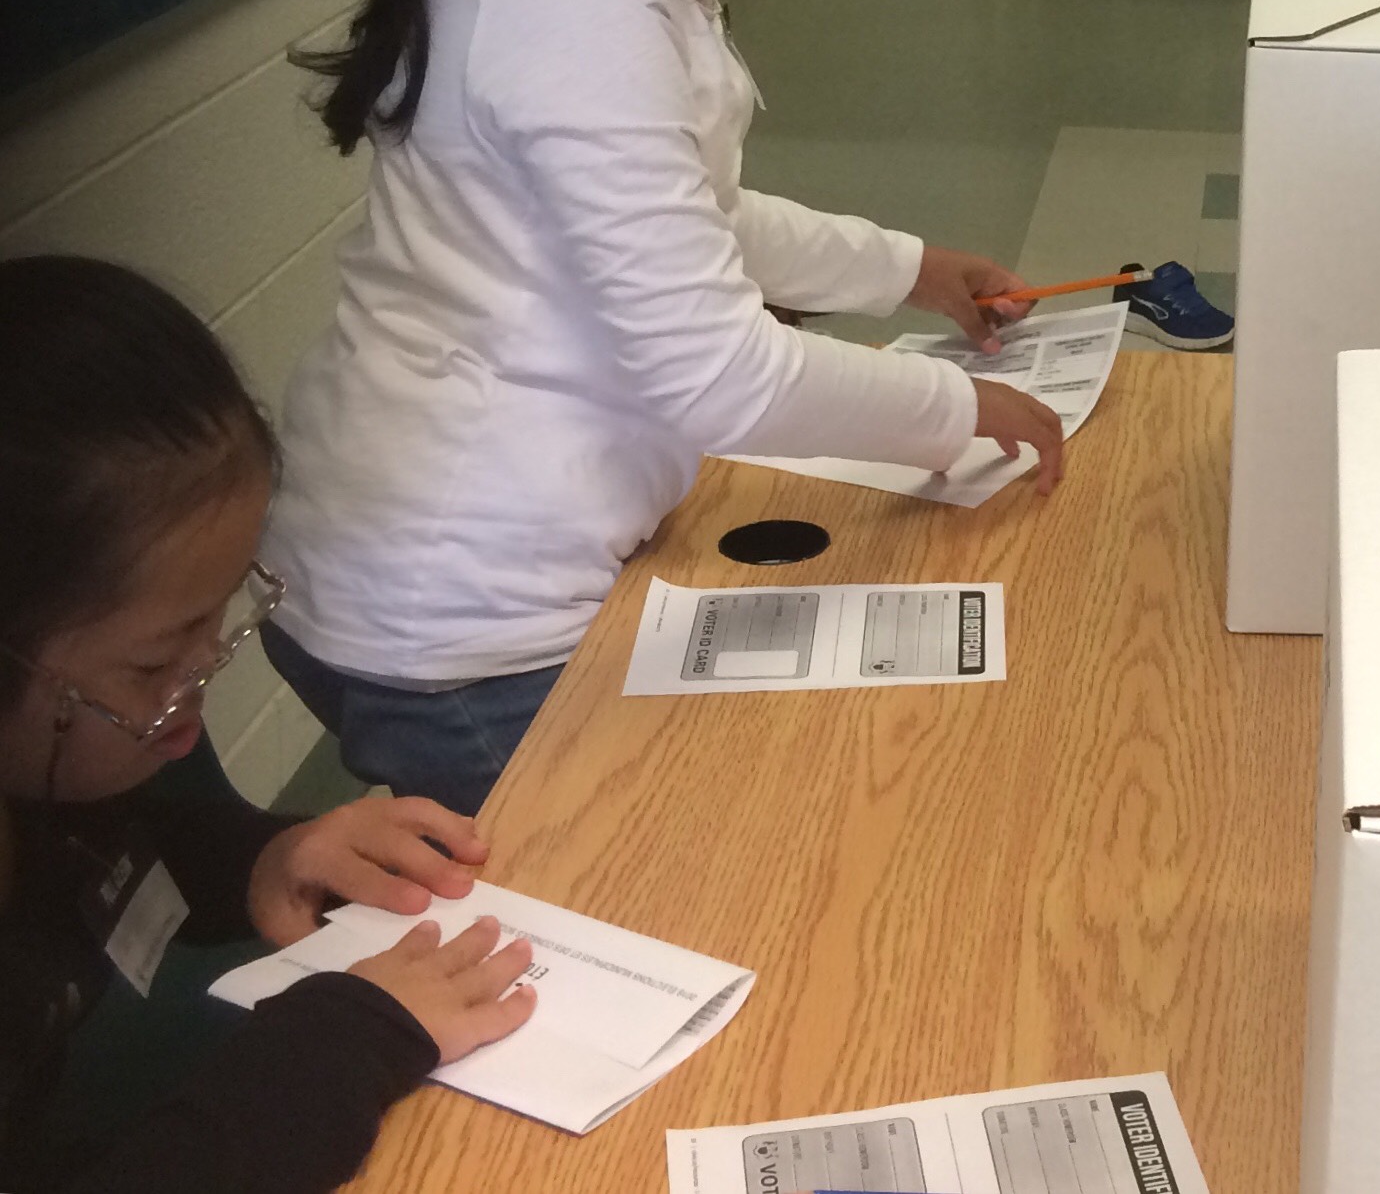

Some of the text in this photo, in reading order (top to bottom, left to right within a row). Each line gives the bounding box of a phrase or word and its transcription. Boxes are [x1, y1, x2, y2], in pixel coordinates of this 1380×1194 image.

[963, 597, 981, 617] VOTER
[692, 609, 719, 674] VOTER ID CARD
[1120, 1103, 1174, 1194] VOTER IDENTIF
[760, 1163, 779, 1194] VOT
